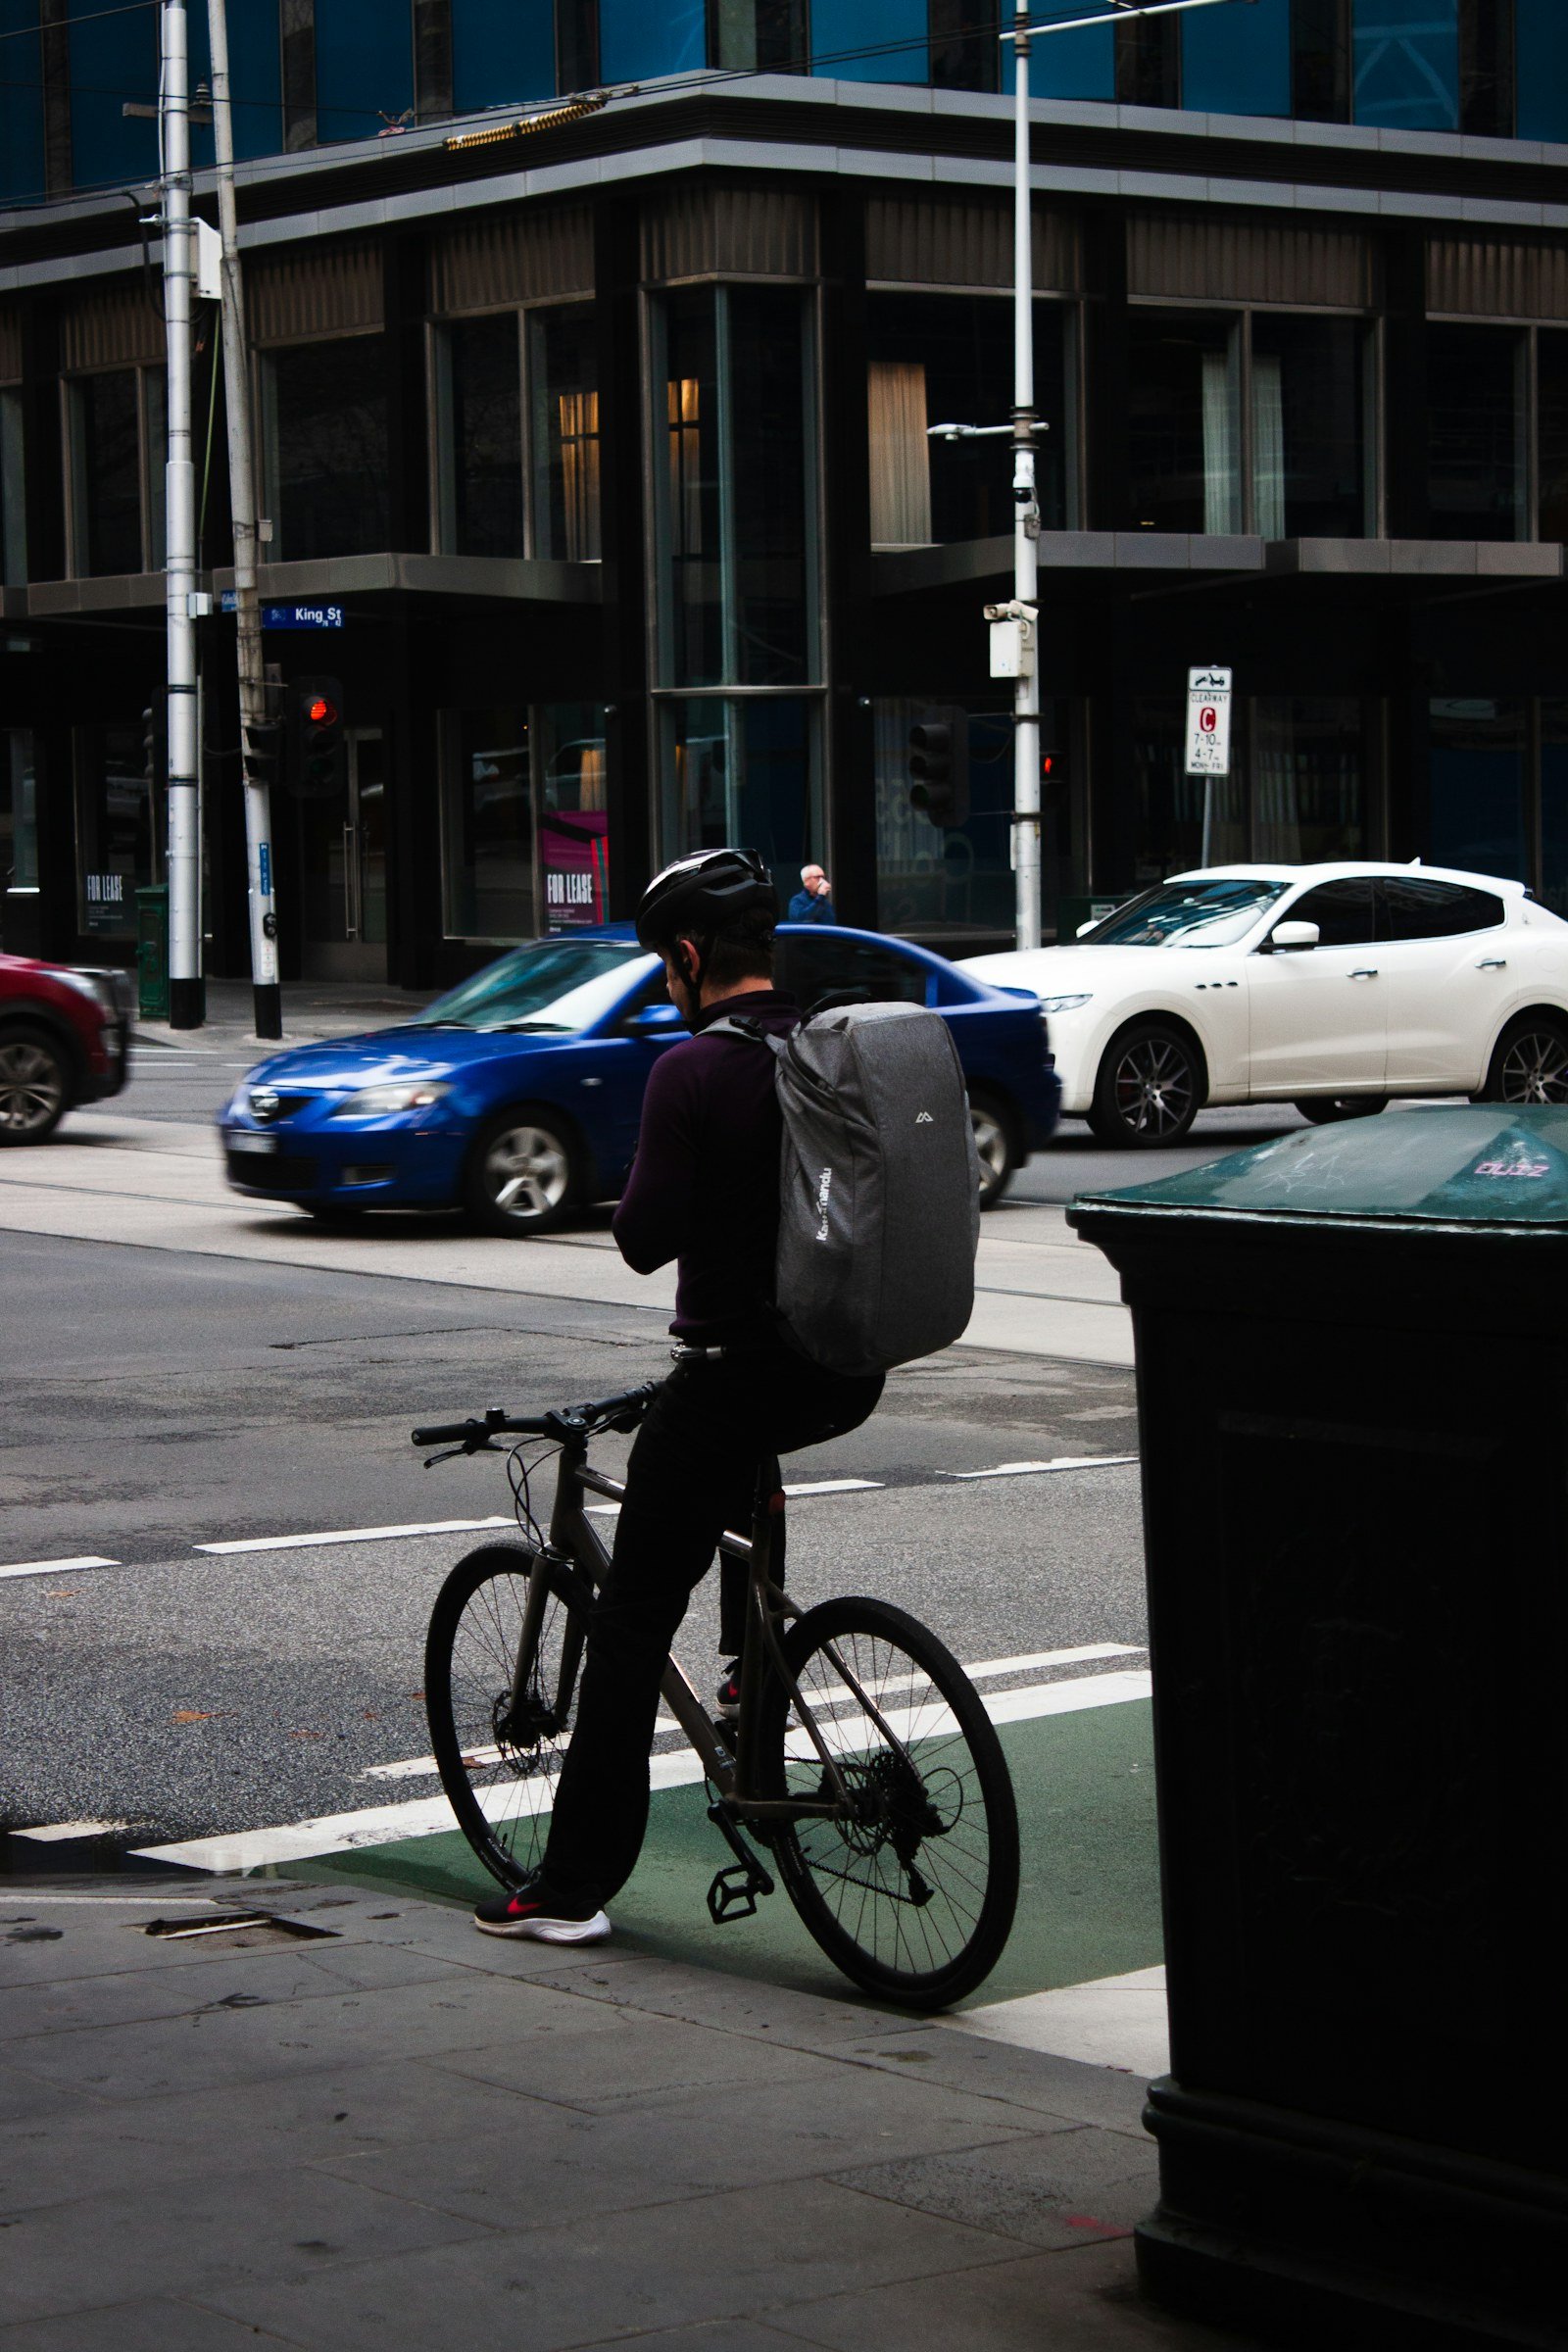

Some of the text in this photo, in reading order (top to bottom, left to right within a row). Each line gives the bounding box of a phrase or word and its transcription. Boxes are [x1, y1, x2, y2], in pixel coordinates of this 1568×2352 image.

[296, 607, 341, 623] King St
[1192, 693, 1227, 704] CLEARWAY
[1200, 707, 1216, 733] C
[87, 875, 122, 901] FOR LEASE
[548, 874, 592, 904] FOR LEASE
